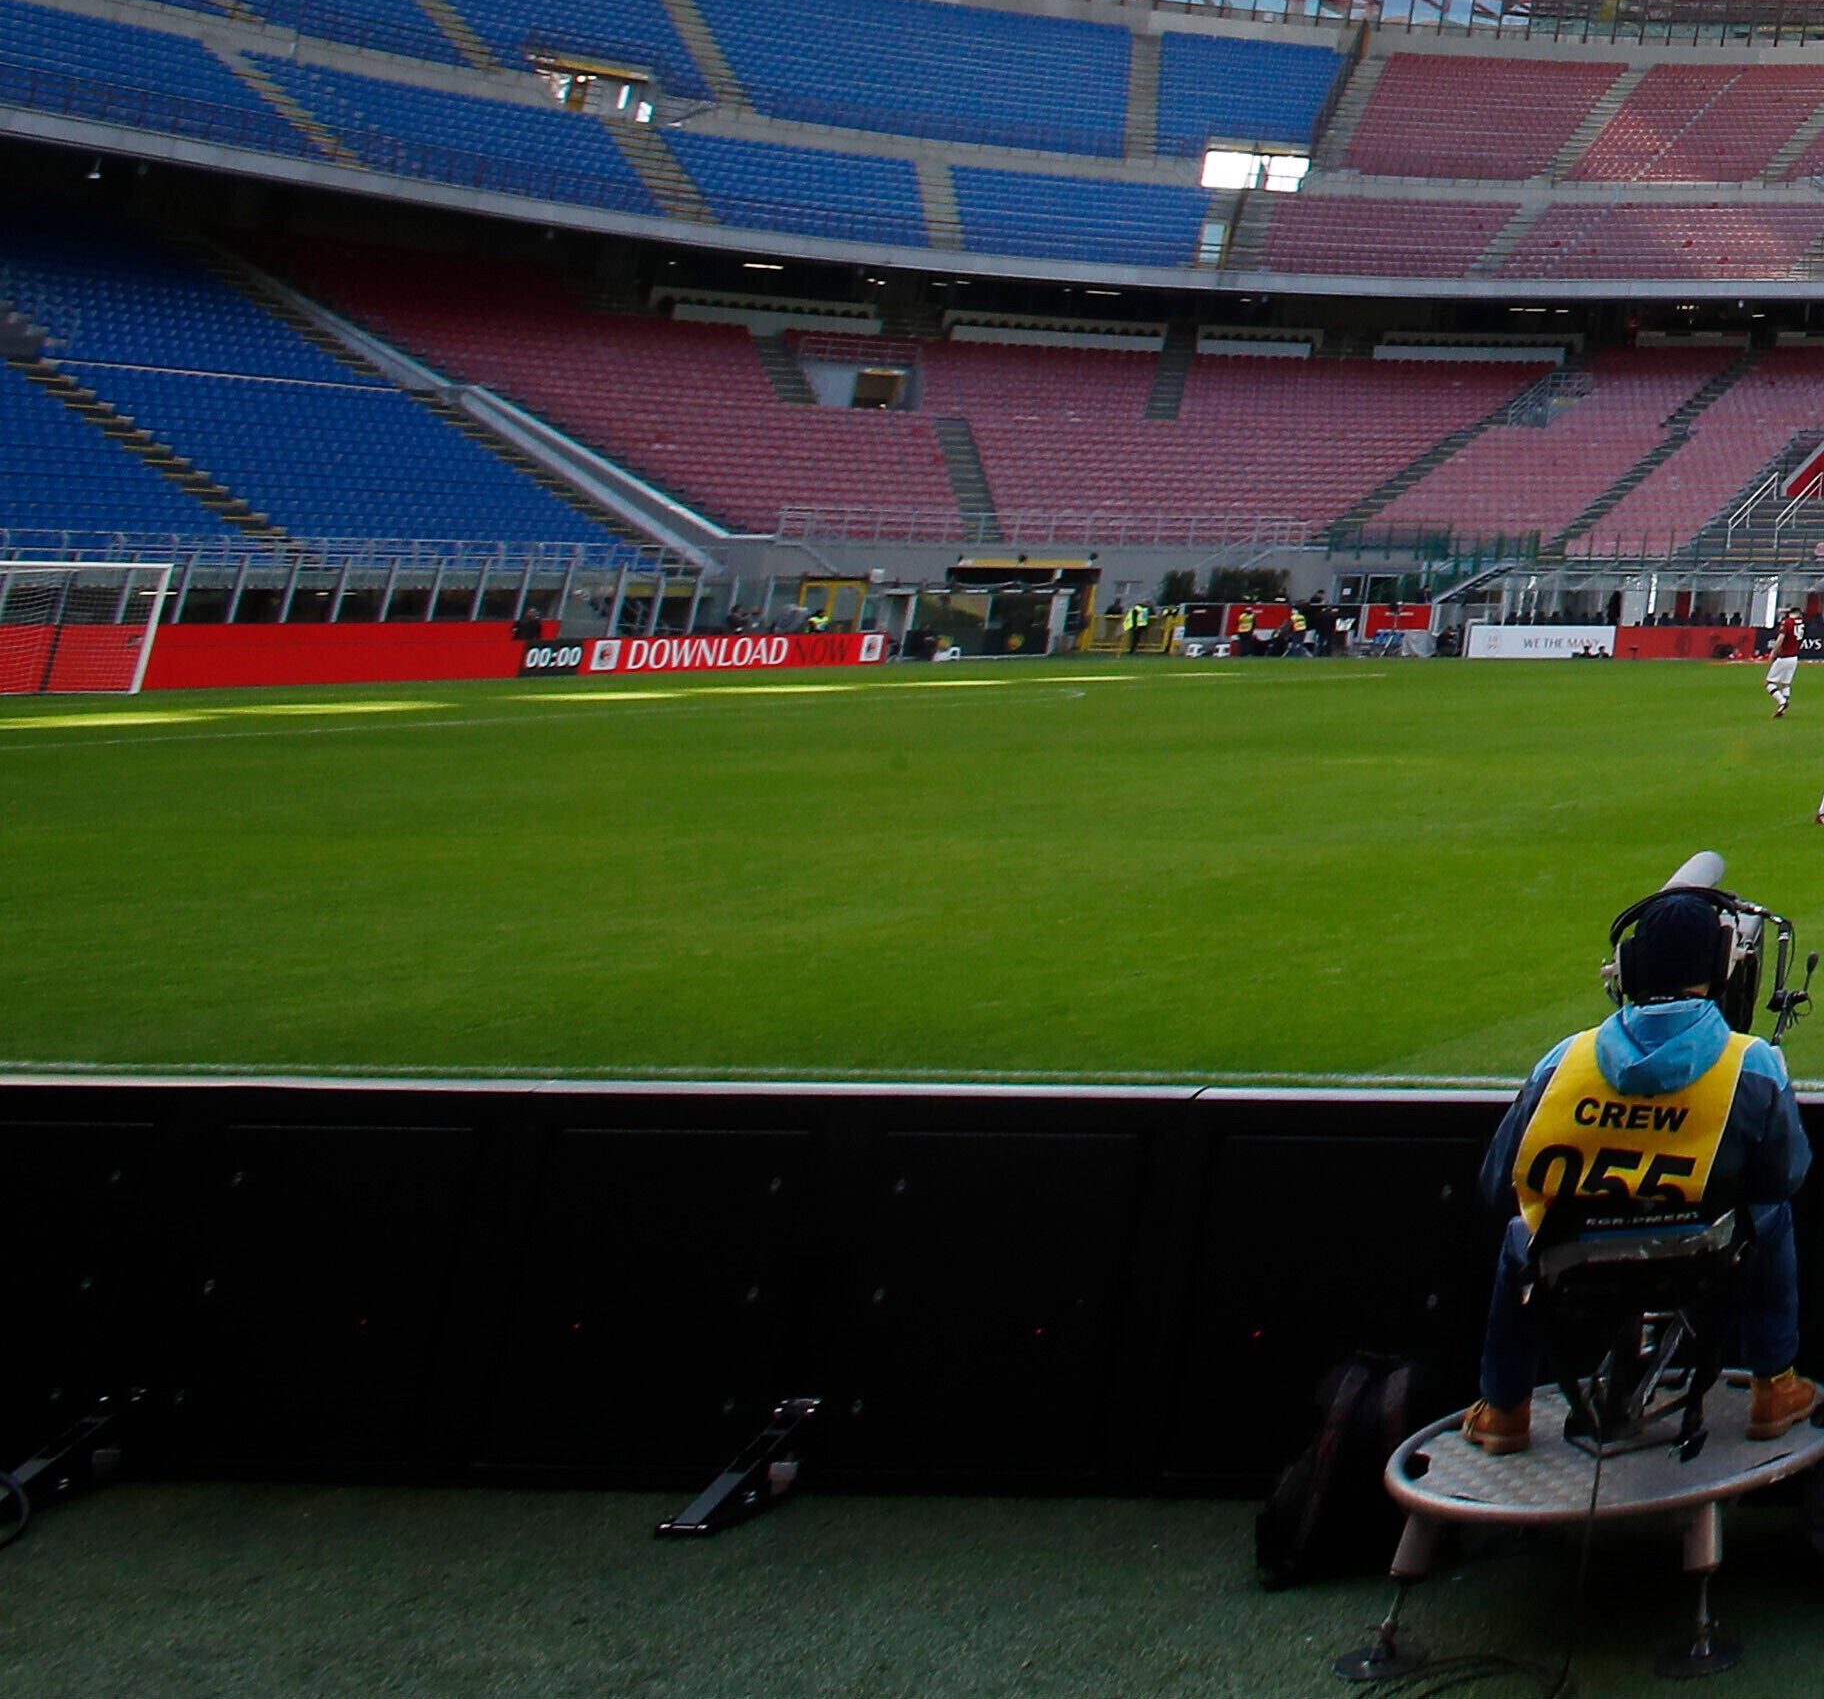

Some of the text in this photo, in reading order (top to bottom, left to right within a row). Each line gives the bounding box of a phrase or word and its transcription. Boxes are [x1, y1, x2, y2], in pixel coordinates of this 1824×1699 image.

[526, 645, 583, 669] 00:00
[626, 636, 848, 670] DOWNLOAD NOW
[1523, 638, 1541, 648] WE
[1543, 638, 1565, 648] THE
[1573, 1097, 1689, 1133] CREW
[1526, 1144, 1698, 1203] 055
